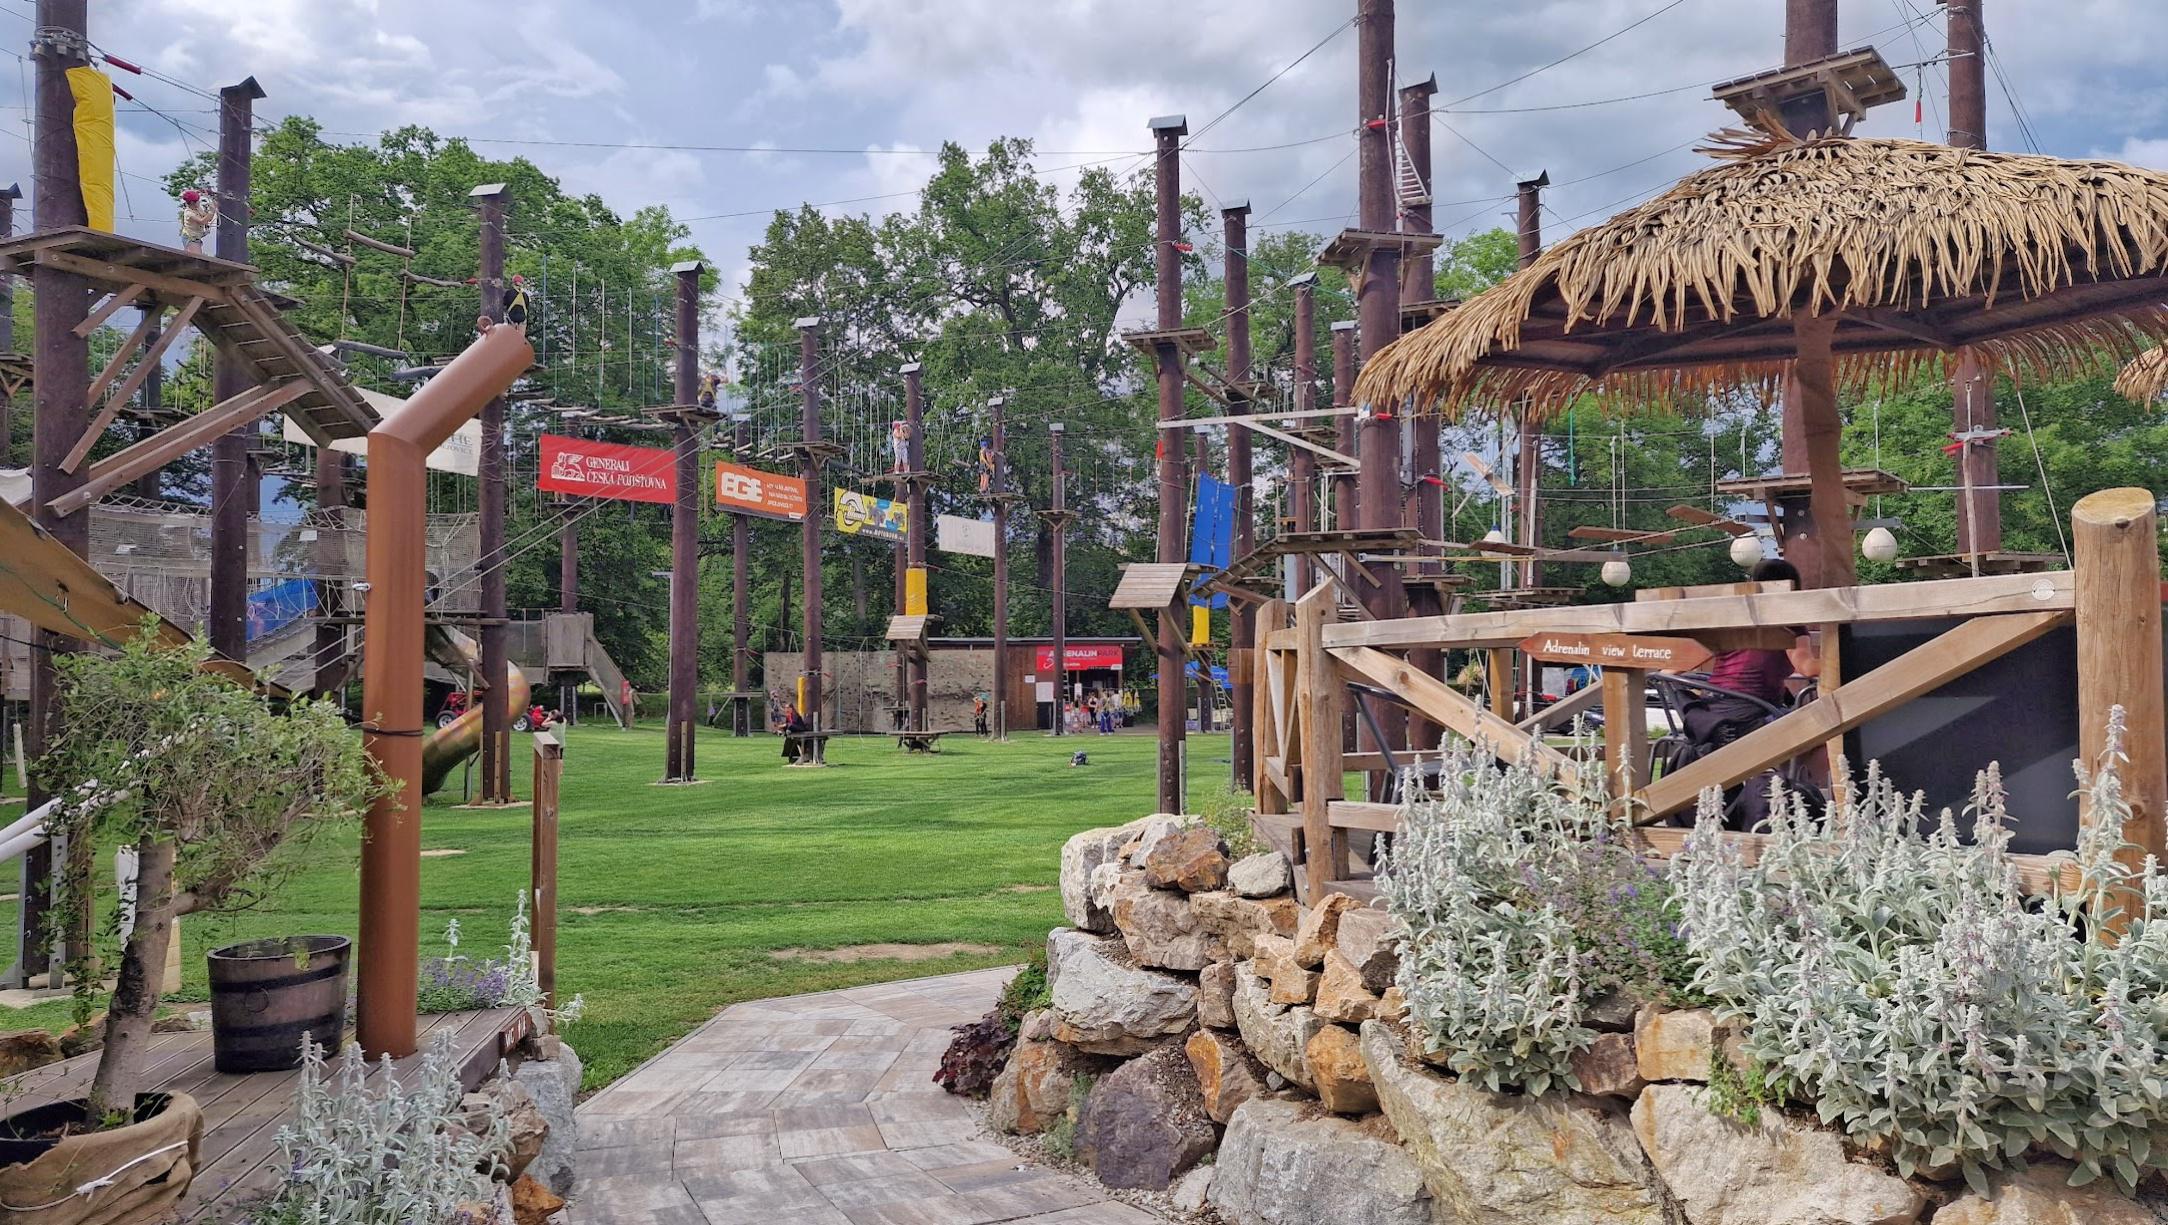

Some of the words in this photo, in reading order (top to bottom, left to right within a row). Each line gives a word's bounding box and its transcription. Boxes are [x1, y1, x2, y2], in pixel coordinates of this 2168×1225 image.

[586, 456, 630, 472] GENERALI
[586, 469, 614, 485] ČESKÁ
[721, 472, 763, 503] EGE
[1543, 639, 1590, 656] Adrenalin
[1602, 645, 1626, 657] view
[1632, 644, 1672, 660] terrace
